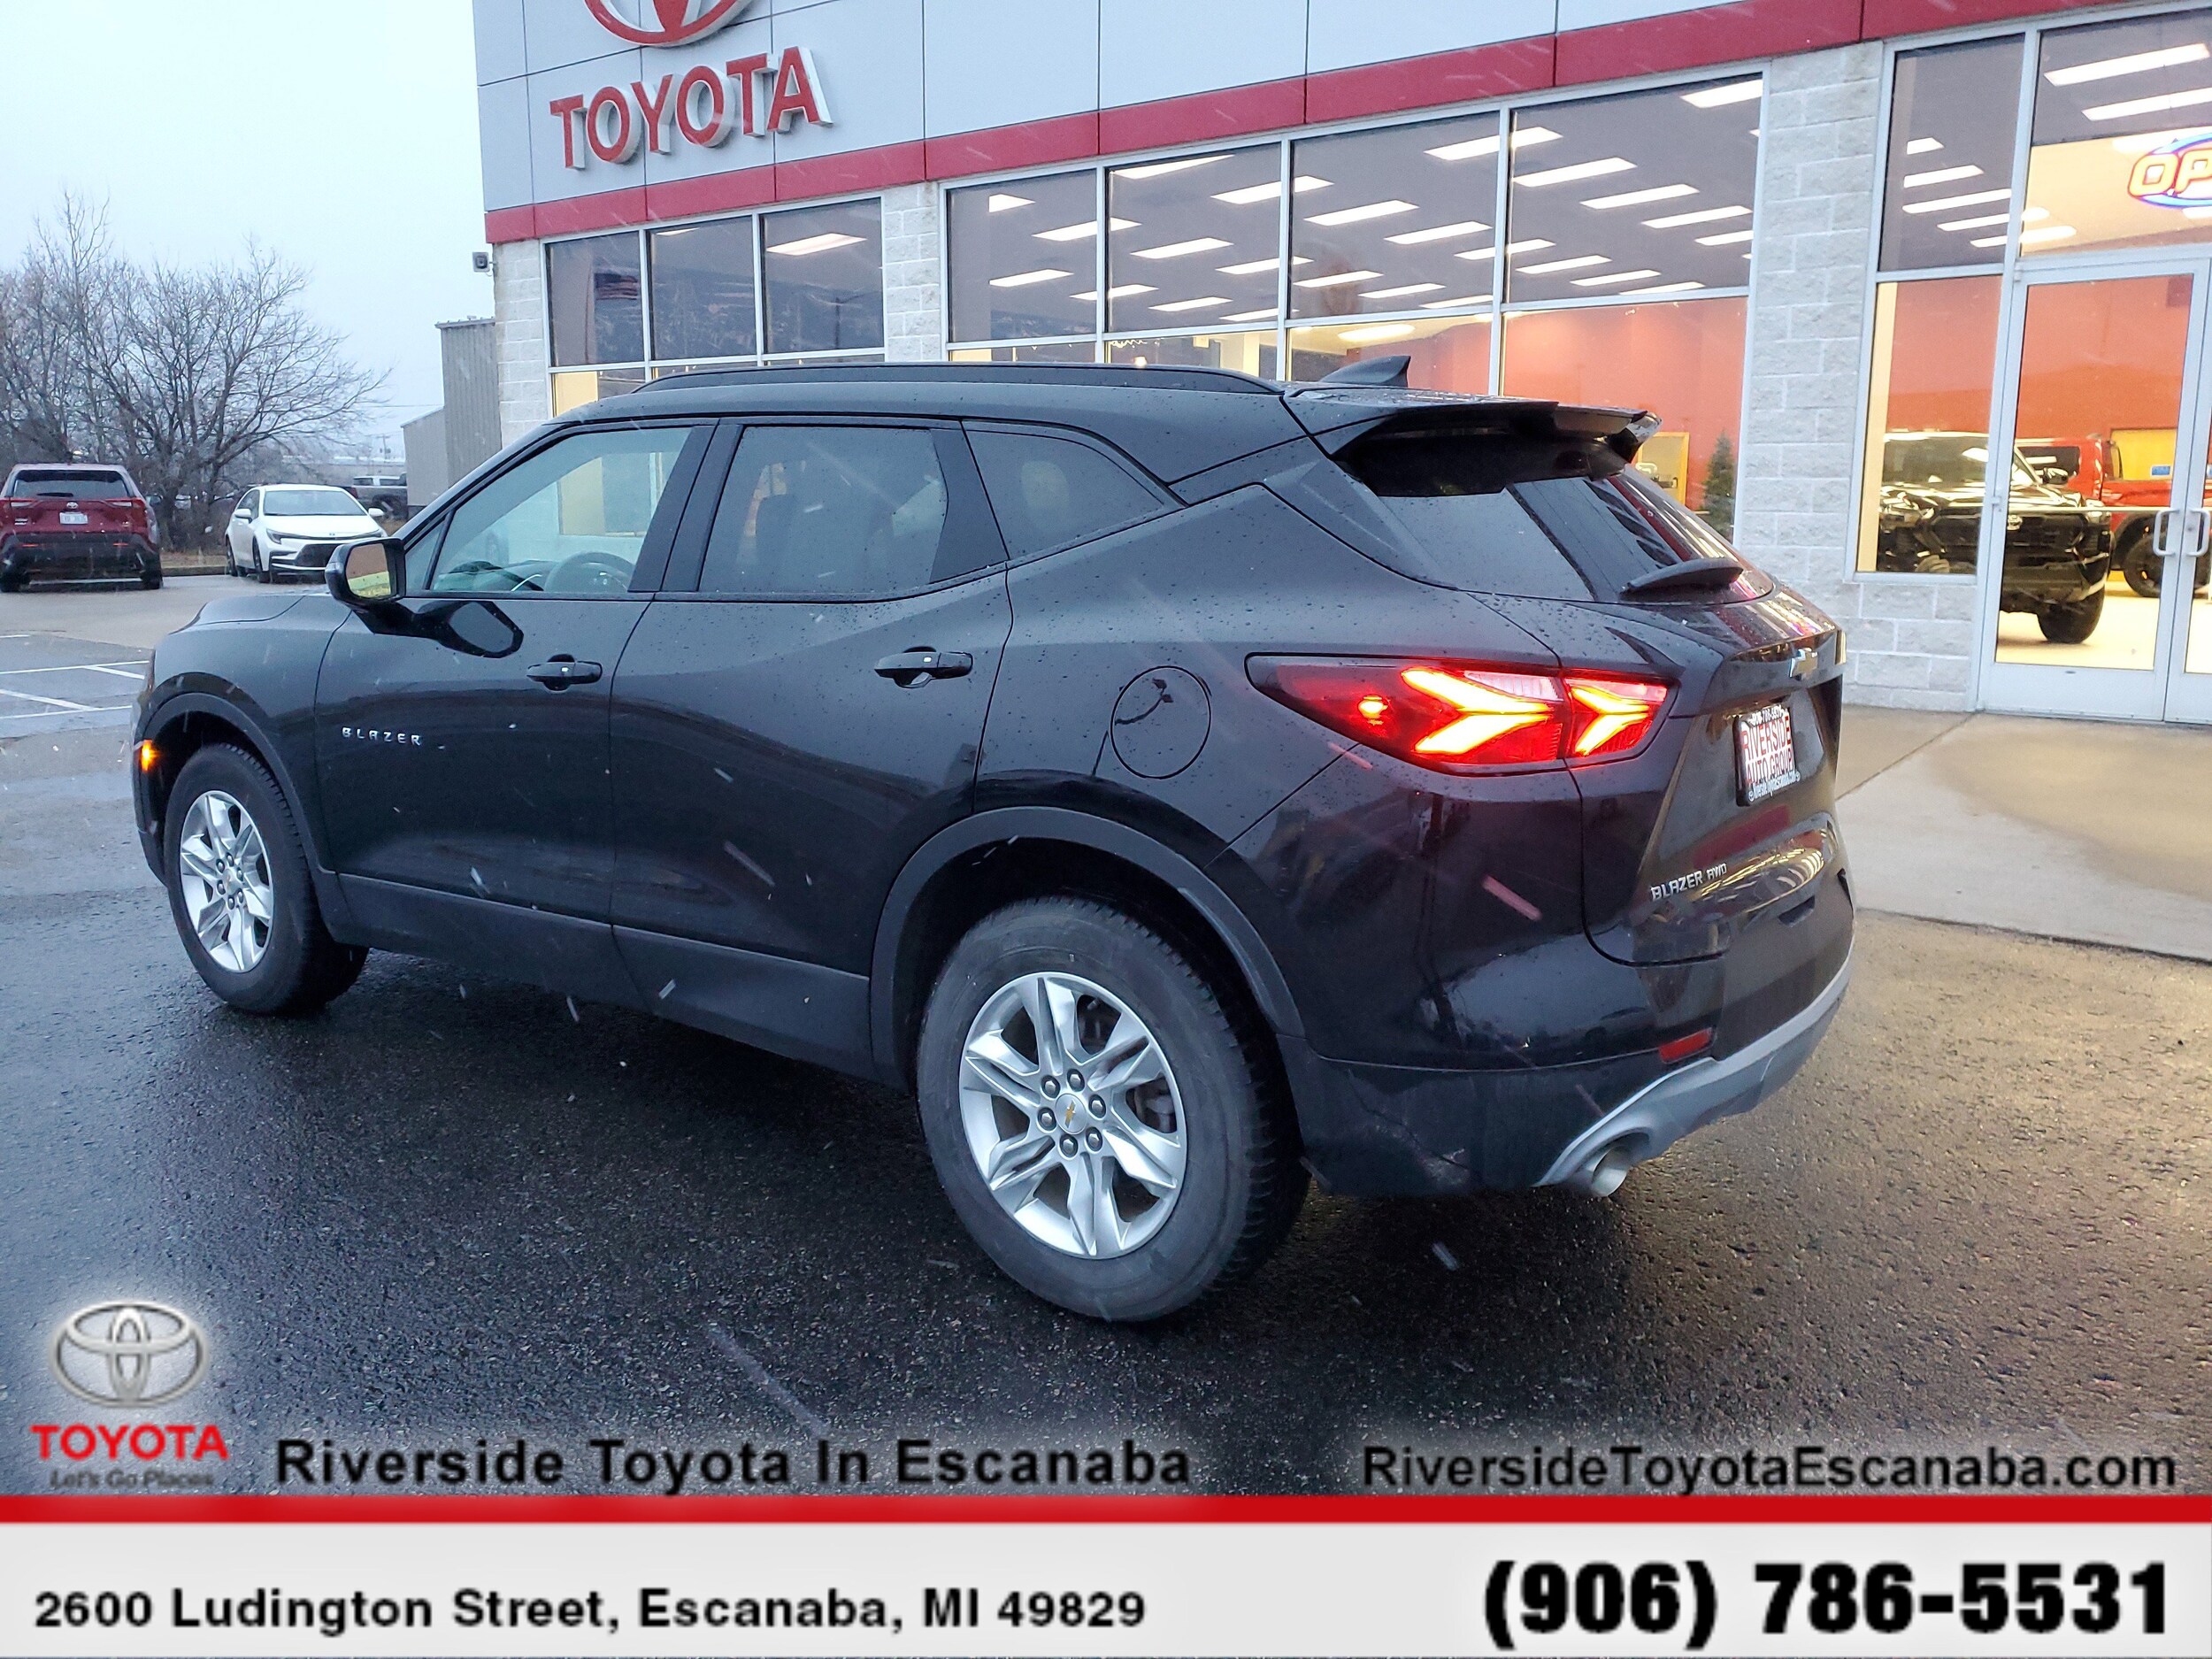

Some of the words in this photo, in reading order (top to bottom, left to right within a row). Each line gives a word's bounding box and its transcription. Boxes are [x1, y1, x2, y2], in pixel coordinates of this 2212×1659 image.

[549, 46, 830, 169] TOYOTA
[342, 726, 422, 746] BLAZER
[1740, 715, 1792, 761] RIVERSIDE
[1747, 757, 1770, 786] AUTO
[1770, 747, 1794, 779] GROUP
[1650, 870, 1703, 902] BLAZER
[1706, 863, 1727, 881] AWD
